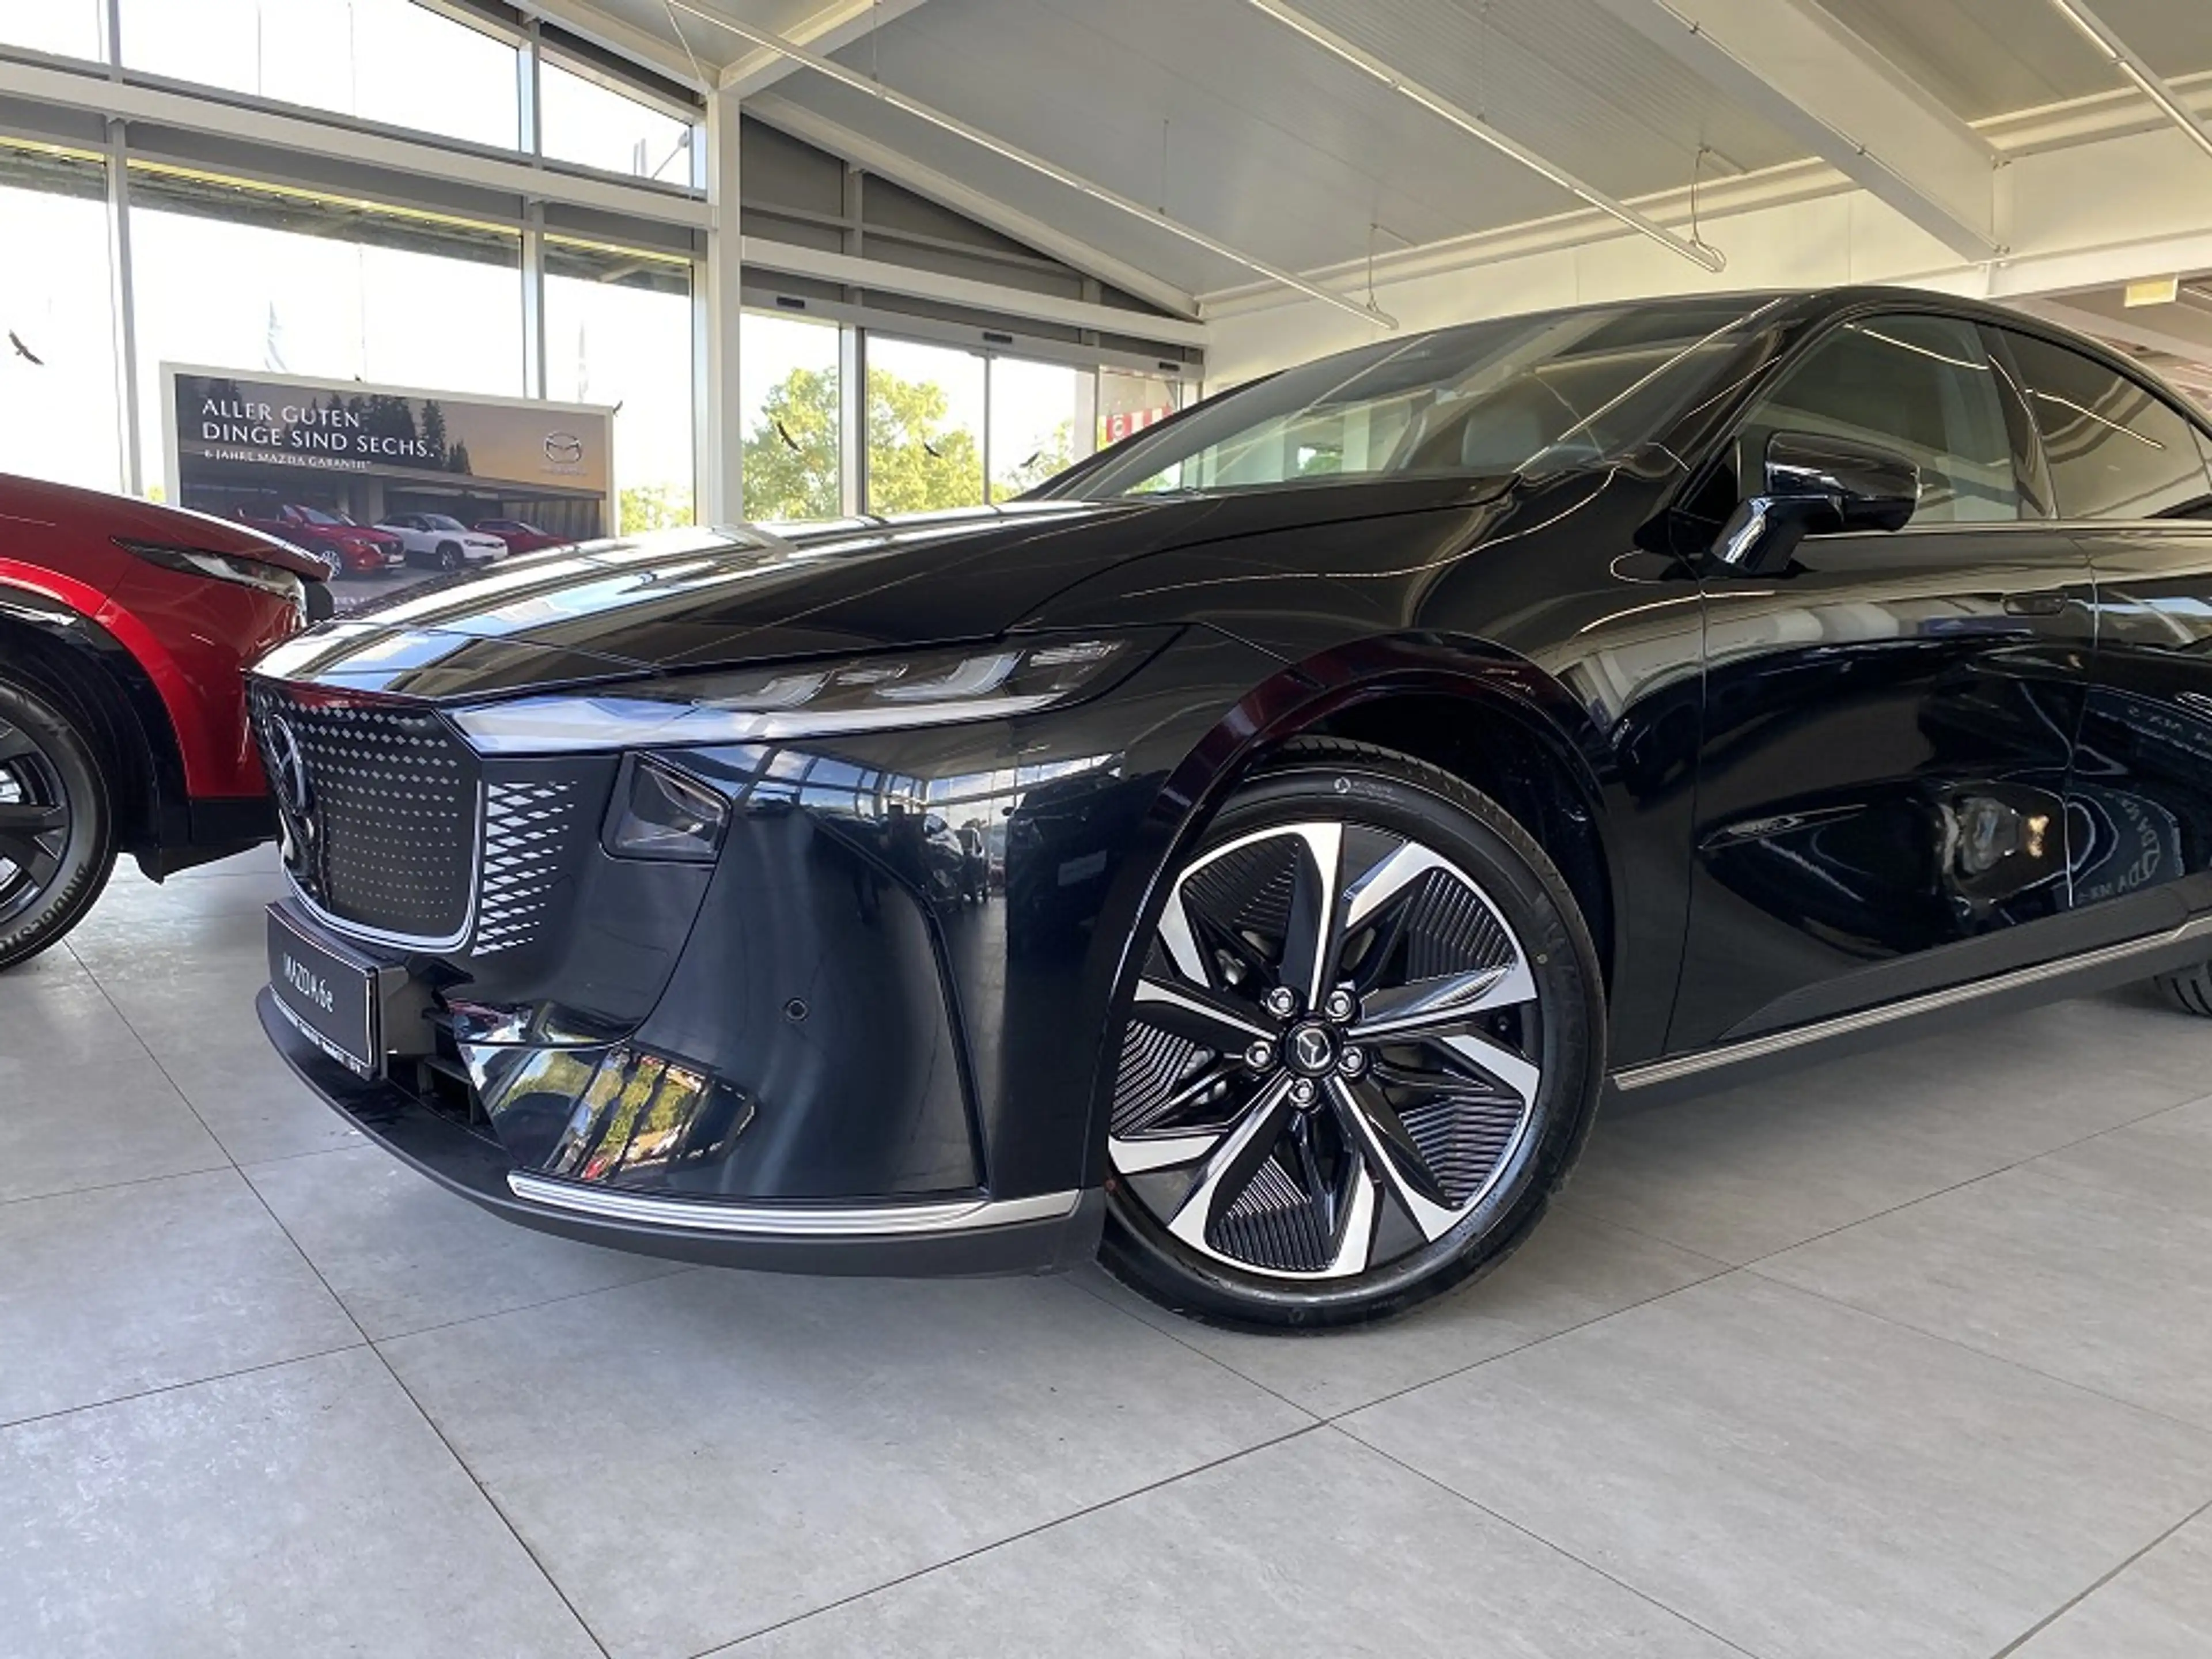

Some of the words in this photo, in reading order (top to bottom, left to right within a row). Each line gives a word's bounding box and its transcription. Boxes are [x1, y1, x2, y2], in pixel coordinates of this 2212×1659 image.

[202, 399, 272, 421] ALLER
[281, 405, 360, 428] GUTEN
[203, 421, 282, 446] DINGE
[291, 430, 348, 451] SIND
[357, 435, 435, 457] SECHS.
[257, 452, 305, 466] MAZDA
